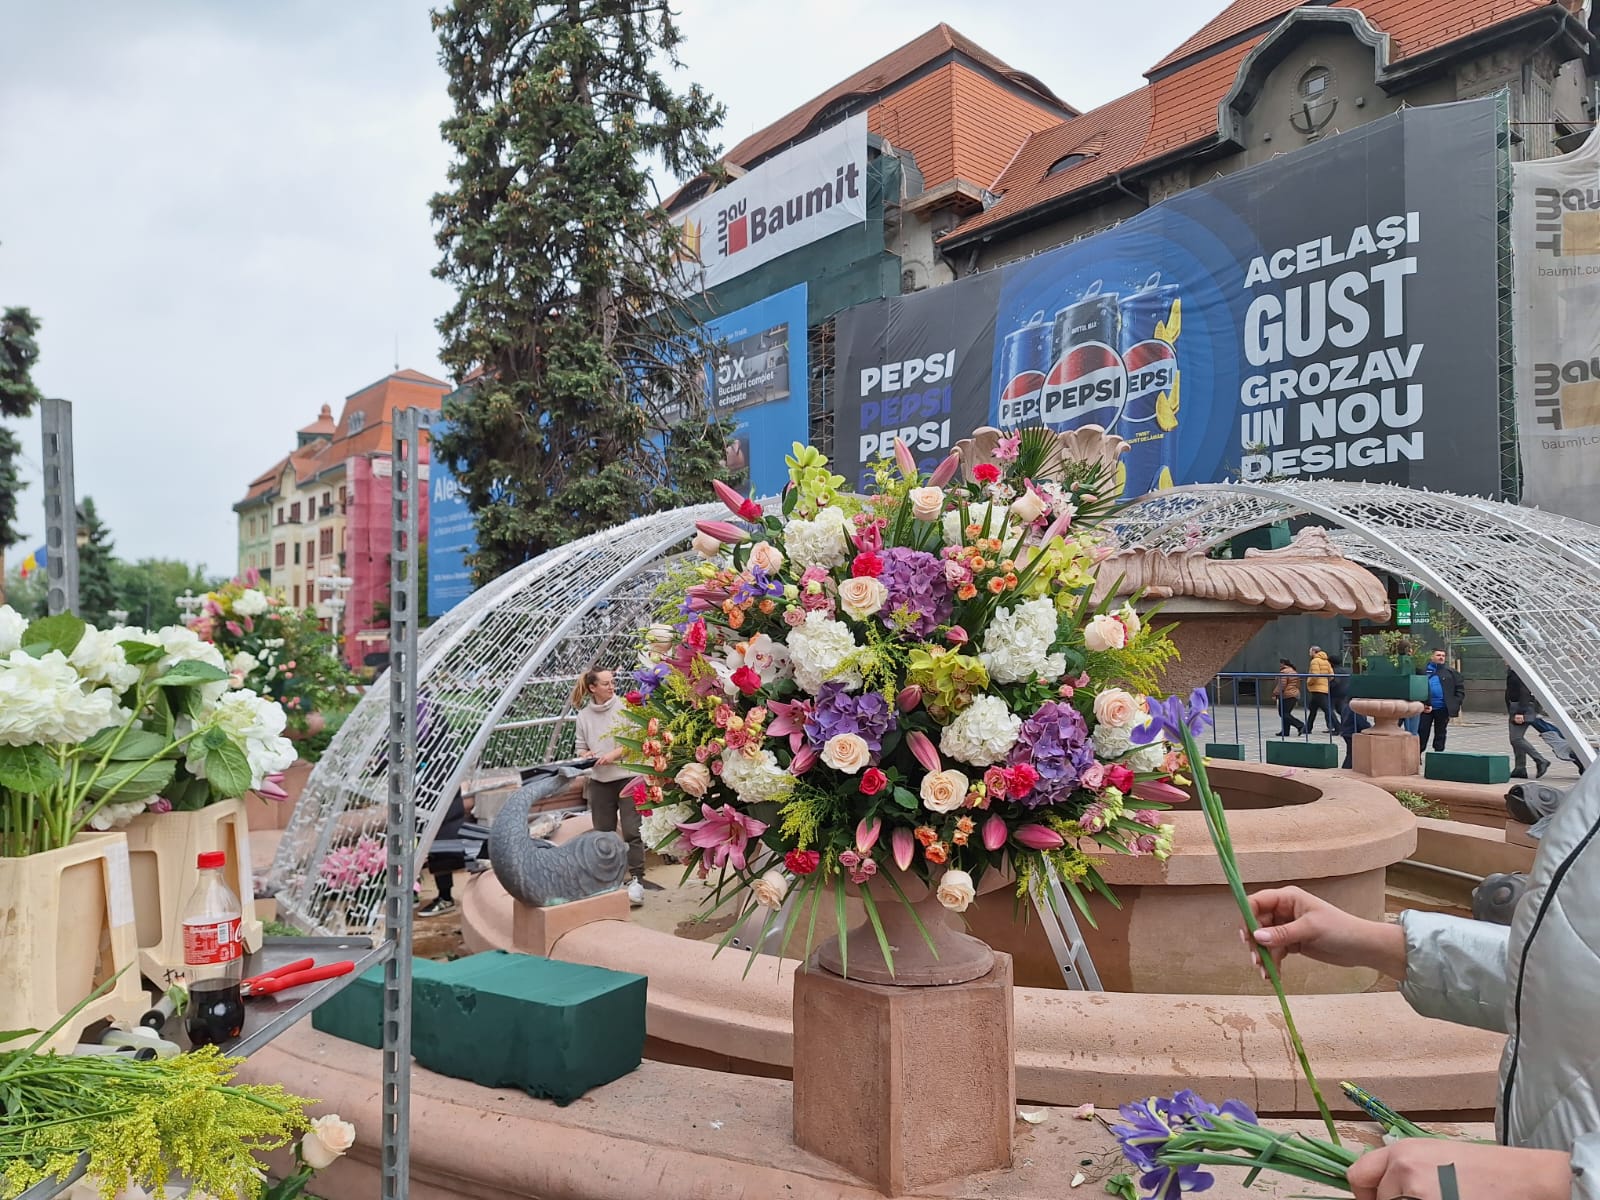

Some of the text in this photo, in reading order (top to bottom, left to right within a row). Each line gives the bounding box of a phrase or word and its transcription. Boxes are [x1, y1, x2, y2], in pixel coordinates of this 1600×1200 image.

[751, 162, 859, 244] Baumit
[1243, 257, 1417, 366] GUST
[748, 370, 774, 387] complet
[860, 349, 956, 397] PEPSI
[1045, 376, 1121, 413] PEPSI
[1240, 343, 1424, 406] GROZAV
[719, 391, 747, 407] echipate
[861, 384, 952, 430] PEPSI
[1241, 384, 1423, 450] UN NOU
[860, 418, 951, 462] PEPSI
[1241, 432, 1424, 480] DESIGN
